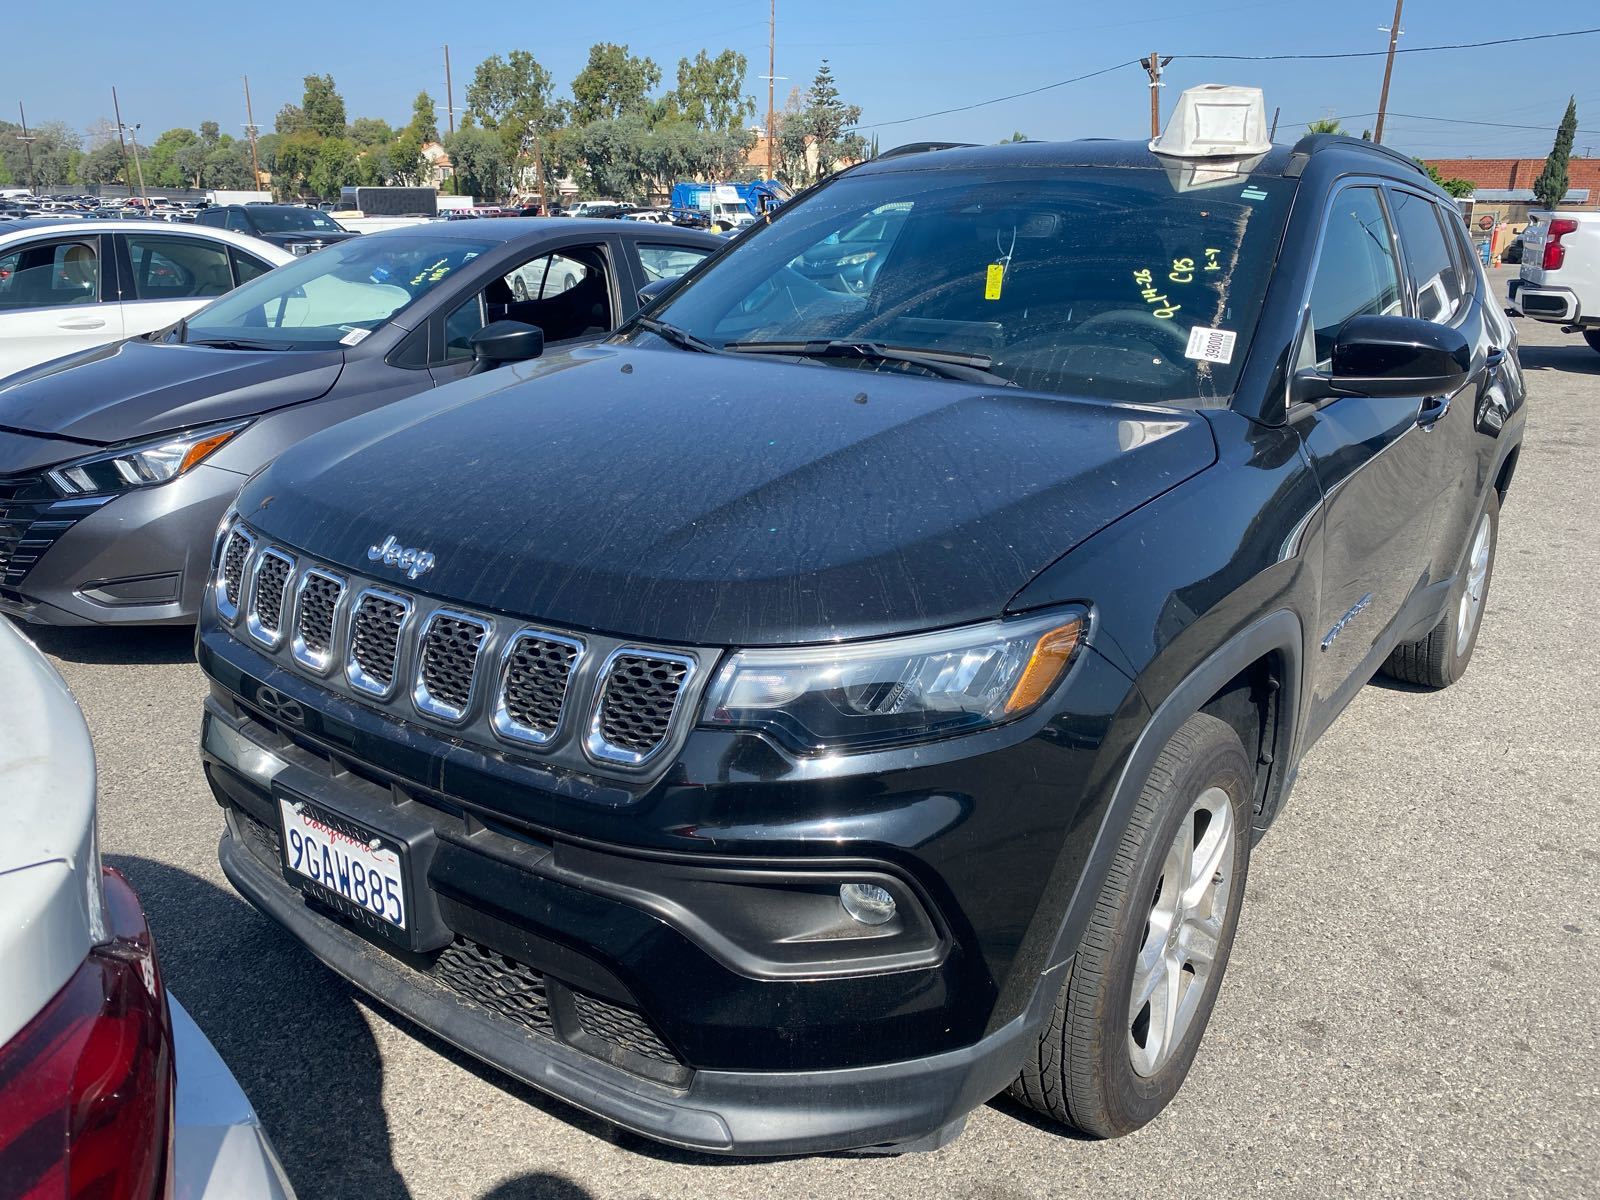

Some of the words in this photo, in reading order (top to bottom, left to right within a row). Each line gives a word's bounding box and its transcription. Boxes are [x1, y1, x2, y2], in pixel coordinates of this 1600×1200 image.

[1204, 332, 1224, 359] 398000
[367, 534, 436, 580] Jeep
[288, 828, 402, 926] 9GAW885
[302, 880, 344, 912] CROWN
[345, 900, 390, 938] TOYOTA
